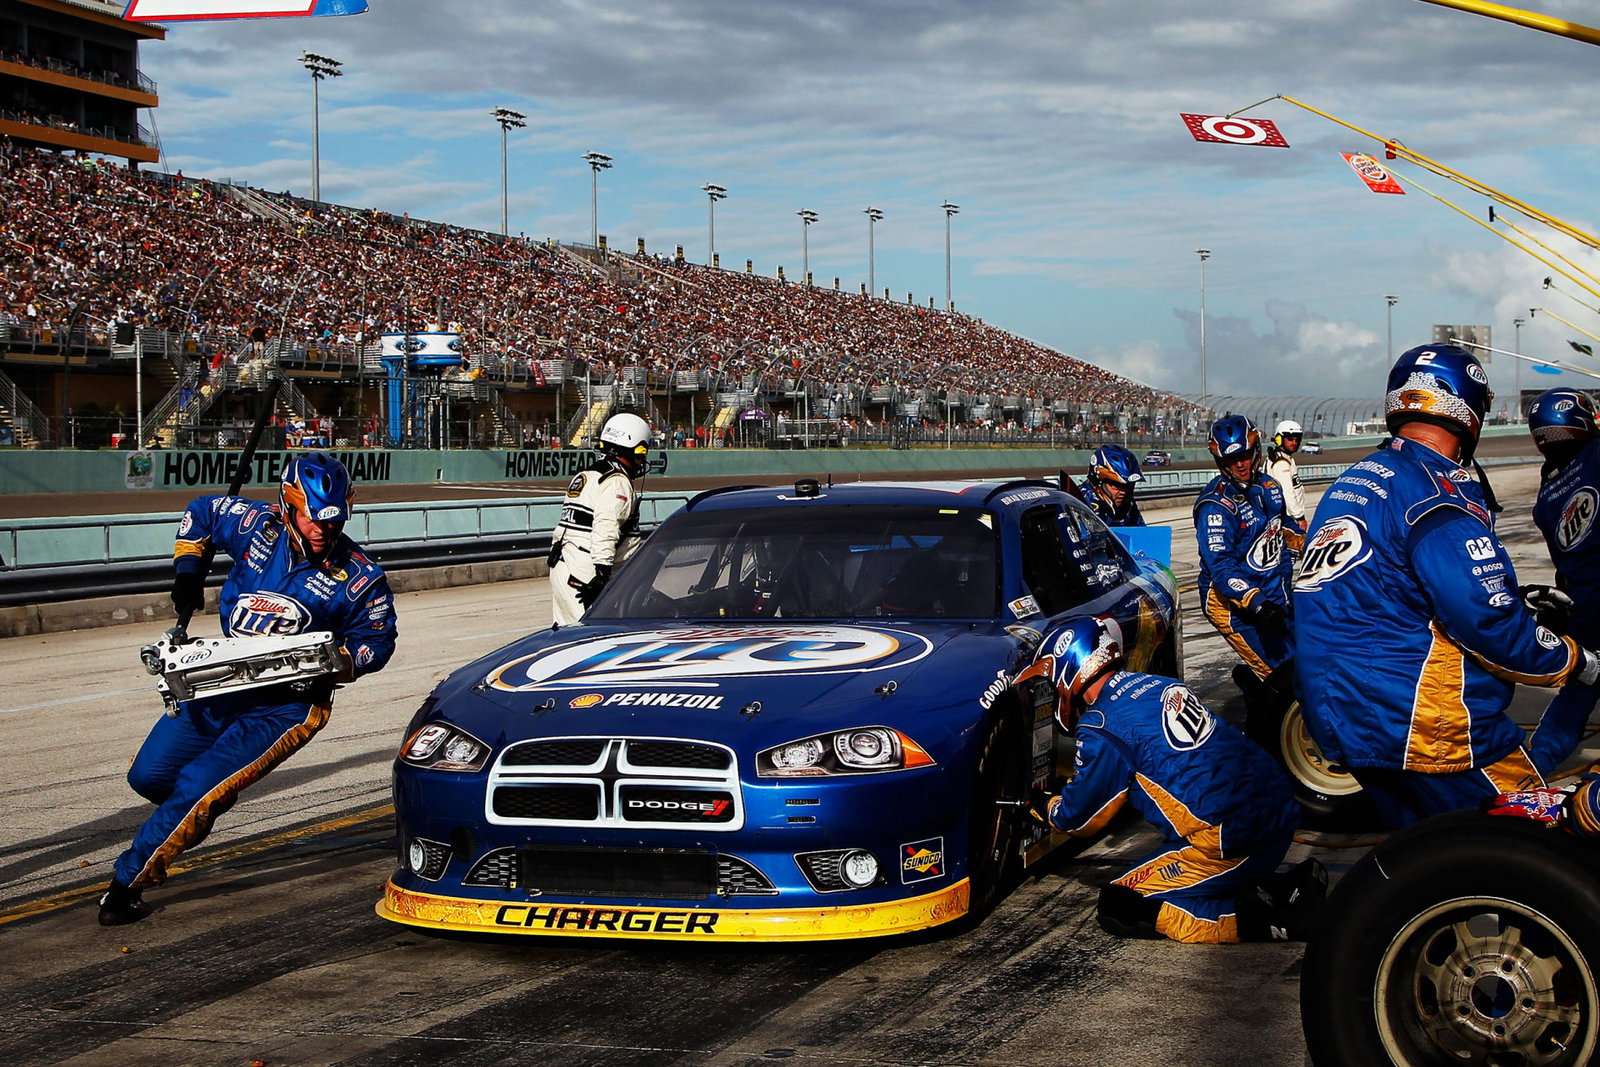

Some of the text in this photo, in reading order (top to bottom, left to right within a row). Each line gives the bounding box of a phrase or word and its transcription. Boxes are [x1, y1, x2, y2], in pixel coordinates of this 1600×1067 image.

[400, 341, 422, 350] Frd
[1415, 351, 1437, 365] 2
[1531, 403, 1540, 414] 2
[1562, 498, 1590, 547] Lite
[1469, 540, 1493, 555] PPG
[250, 596, 289, 613] Miller
[231, 606, 298, 637] Lite
[604, 693, 724, 710] PENNZOIL
[411, 727, 446, 753] 2
[629, 800, 714, 811] DODGE
[905, 853, 940, 868] SUNOCO
[1157, 861, 1185, 881] TIME
[496, 905, 719, 934] CHARGER
[1270, 926, 1288, 939] N
